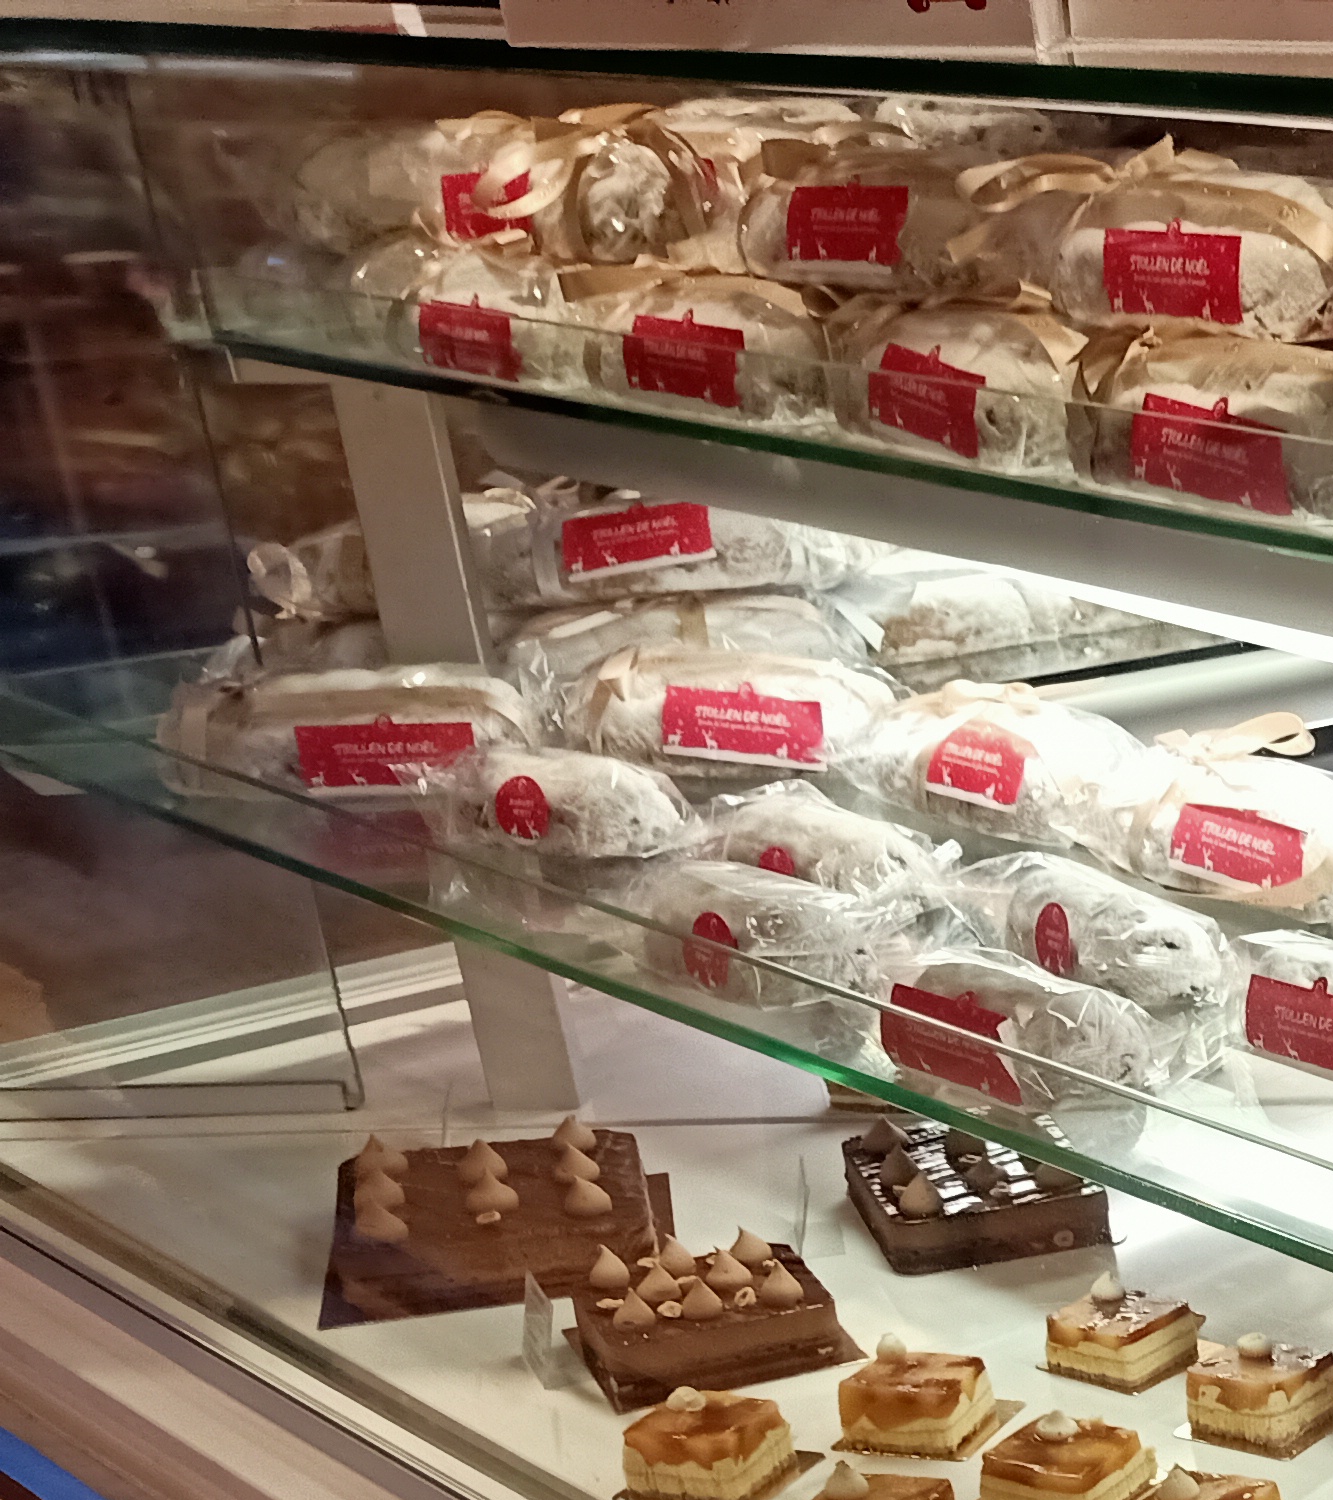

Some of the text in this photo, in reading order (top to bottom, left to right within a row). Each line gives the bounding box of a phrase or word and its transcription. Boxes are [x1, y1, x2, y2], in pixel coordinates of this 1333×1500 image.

[1171, 257, 1184, 274] DE
[695, 705, 742, 722] STOLLEN
[743, 710, 759, 723] DE
[1238, 832, 1253, 848] DE
[1274, 1005, 1317, 1029] STOLLEN
[1319, 1016, 1332, 1030] DE
